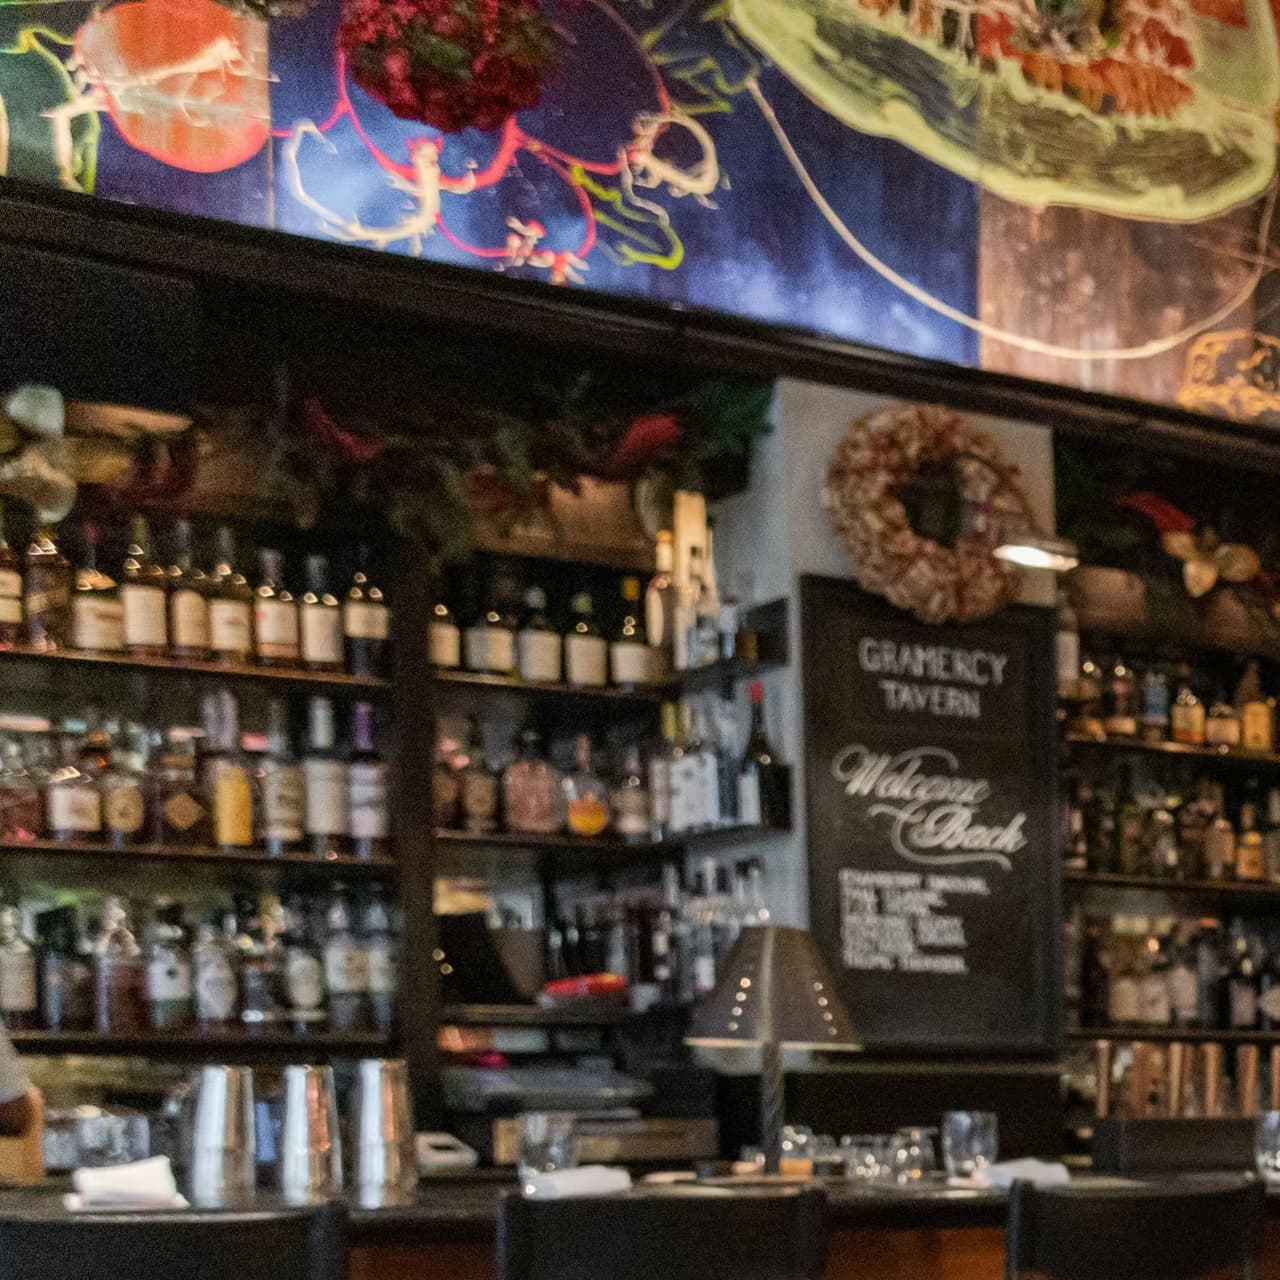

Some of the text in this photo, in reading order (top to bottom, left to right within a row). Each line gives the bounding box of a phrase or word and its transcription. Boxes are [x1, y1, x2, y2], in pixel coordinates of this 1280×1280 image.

[857, 636, 1007, 686] GRAMERCY
[879, 679, 981, 718] TAVERN
[831, 744, 993, 804] Welcome
[888, 801, 1029, 871] Back
